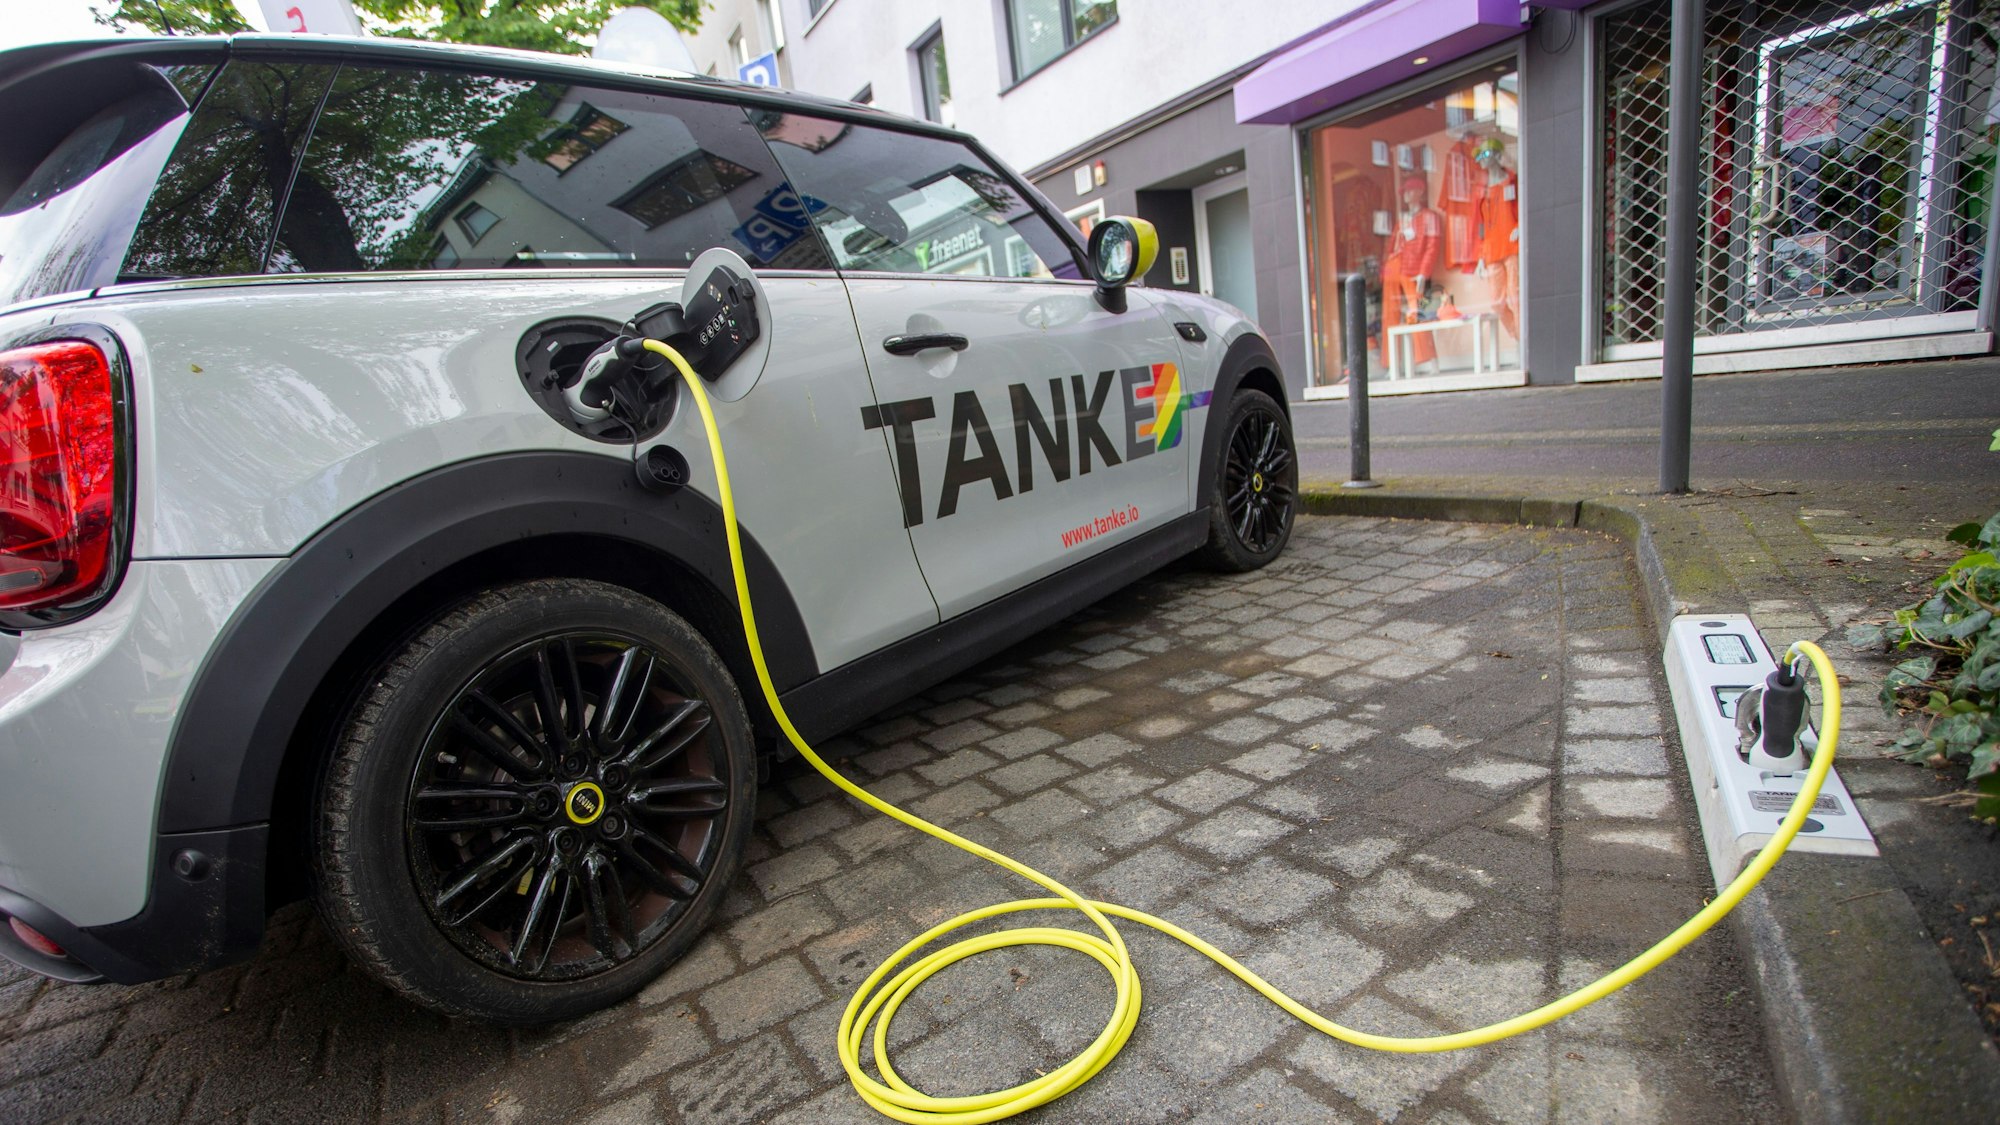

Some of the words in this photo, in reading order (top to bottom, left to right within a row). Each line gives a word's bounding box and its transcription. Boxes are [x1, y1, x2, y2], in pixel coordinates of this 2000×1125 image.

[860, 364, 1157, 529] TANKE
[1061, 503, 1139, 549] www.tanke.io
[576, 793, 596, 813] MINI
